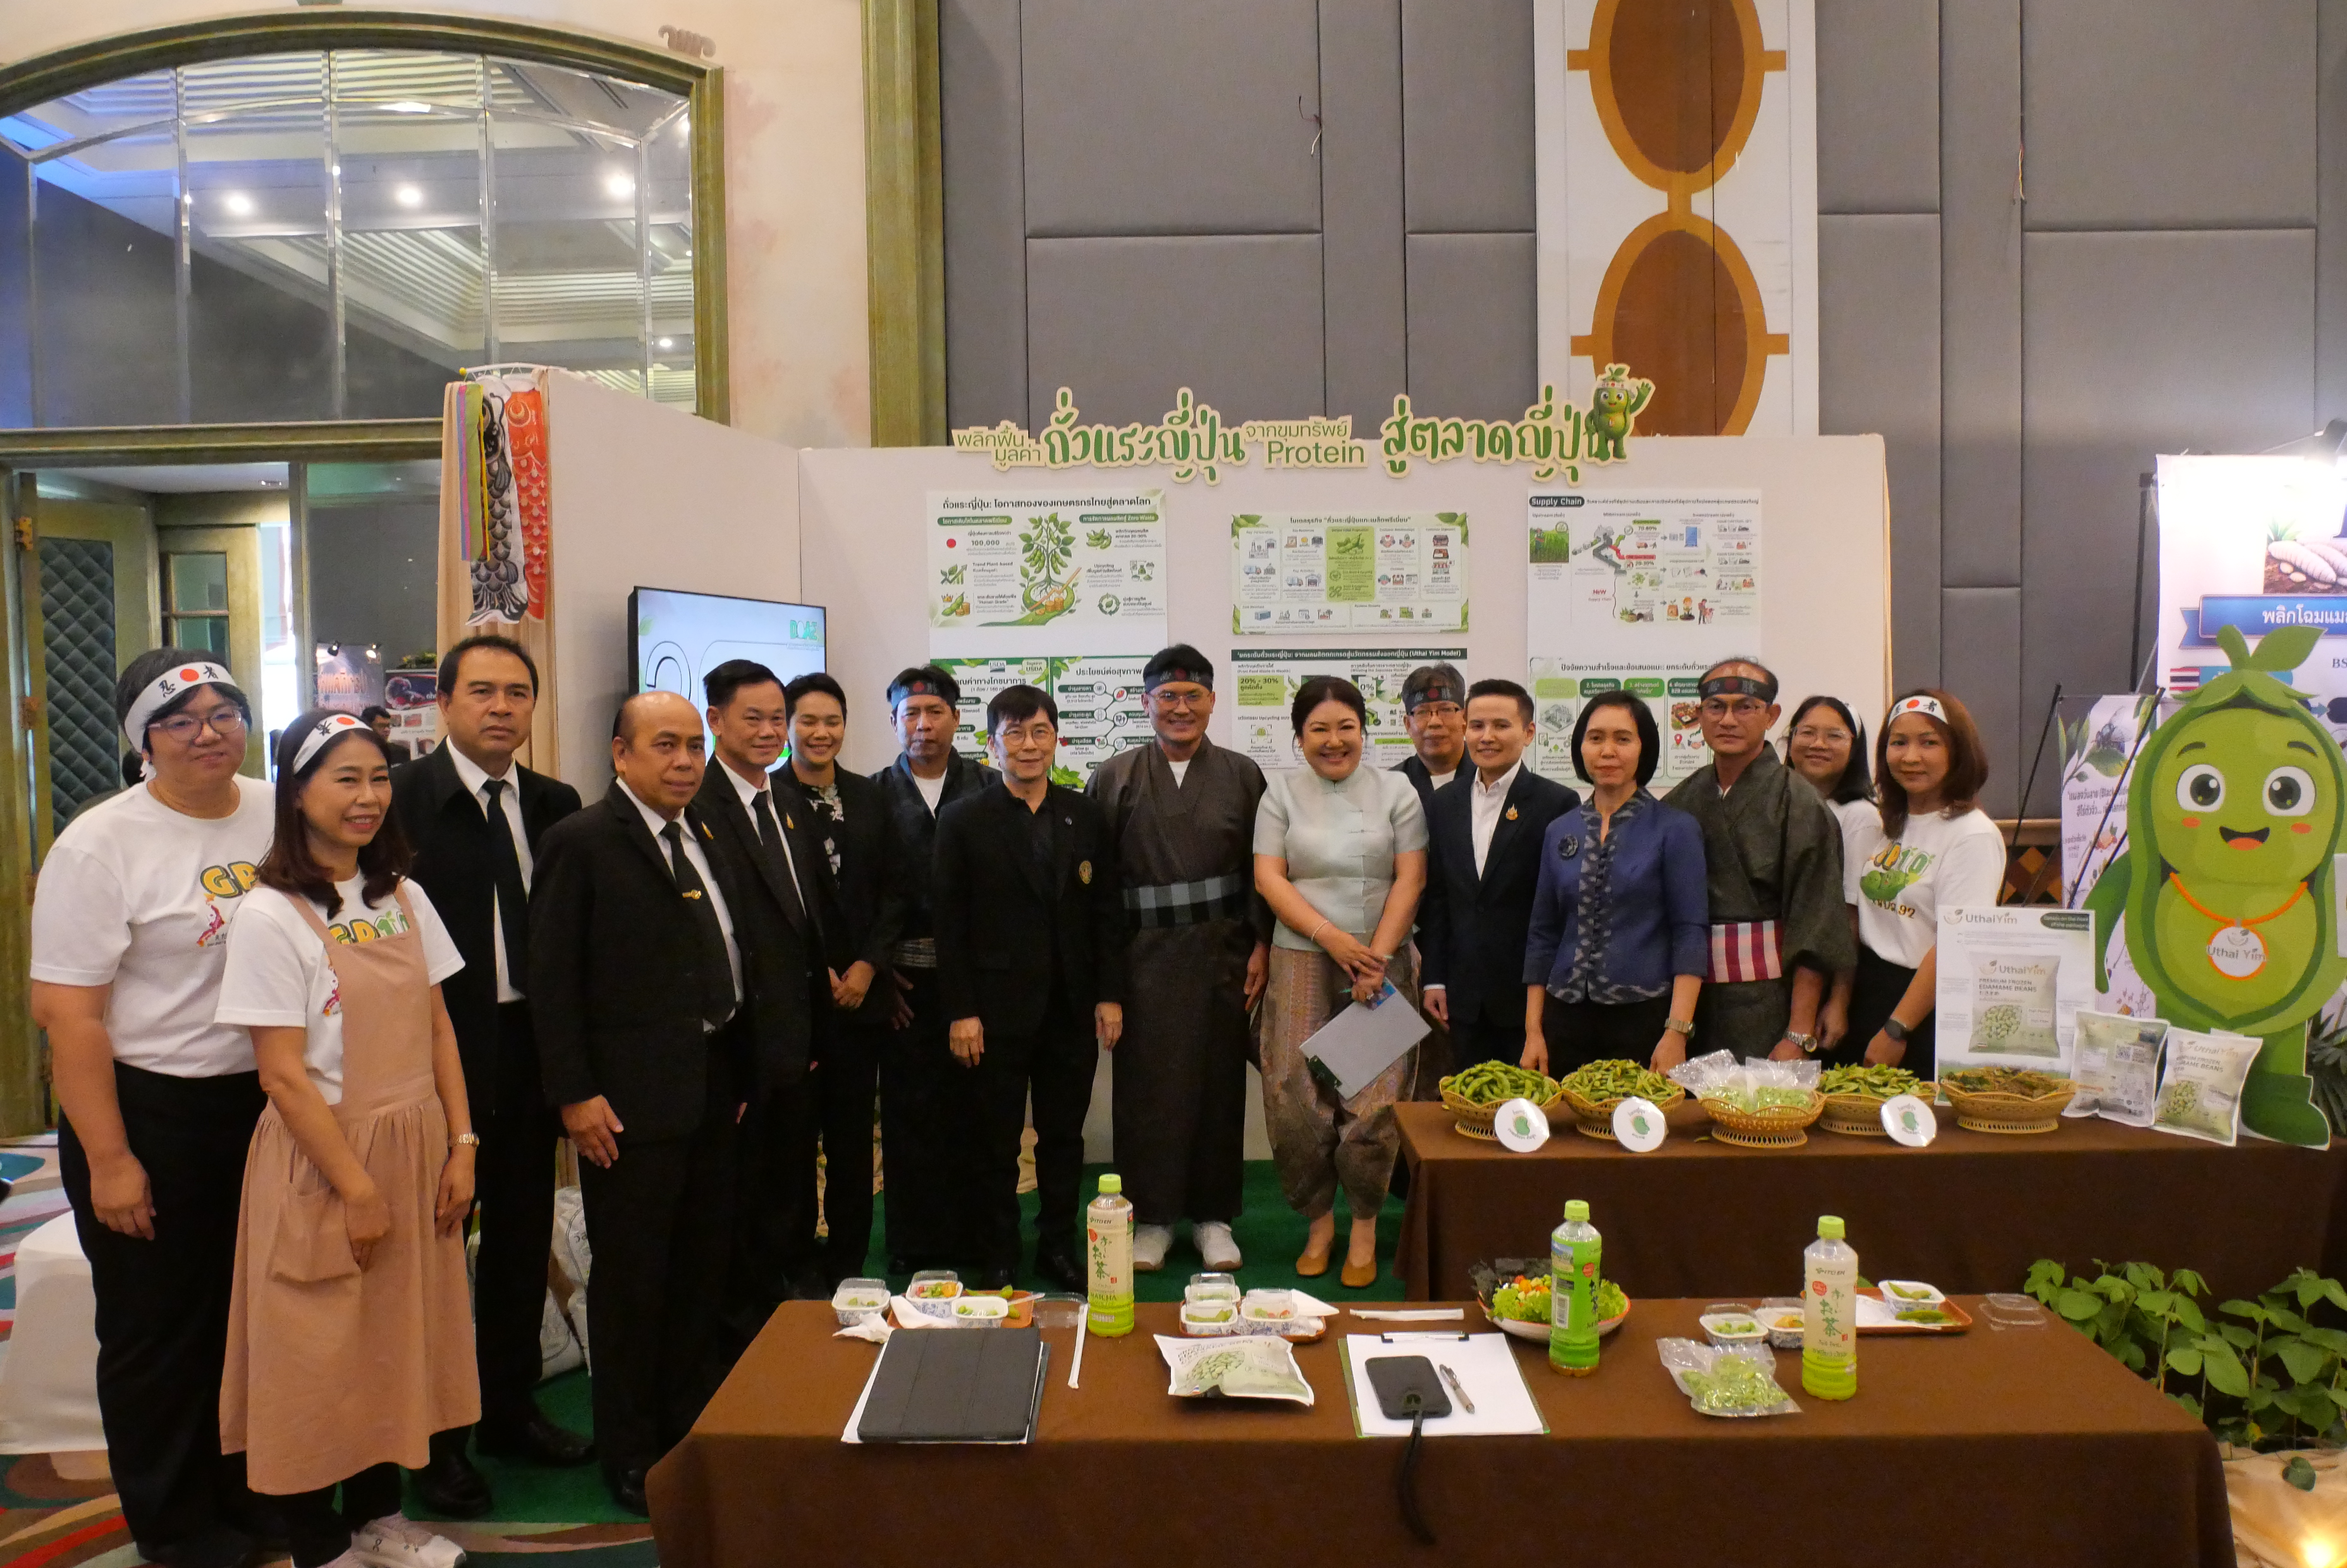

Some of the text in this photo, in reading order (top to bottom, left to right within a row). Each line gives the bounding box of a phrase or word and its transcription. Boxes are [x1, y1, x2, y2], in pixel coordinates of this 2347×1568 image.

[957, 425, 1024, 448] พลิกฟื้น
[1044, 391, 1246, 482] ถั่วแระญี่ปุ่น
[1246, 419, 1348, 441] จากขุมทรัพย์
[995, 443, 1041, 466] มูลค่า
[1266, 440, 1365, 464] Protein
[1531, 497, 1582, 507] Supply Chain
[971, 539, 1000, 548] 100,000
[2262, 604, 2347, 625] พลิกโฉมแม
[2206, 945, 2266, 962] Uthai Yim
[2200, 1063, 2224, 1073] BEANS
